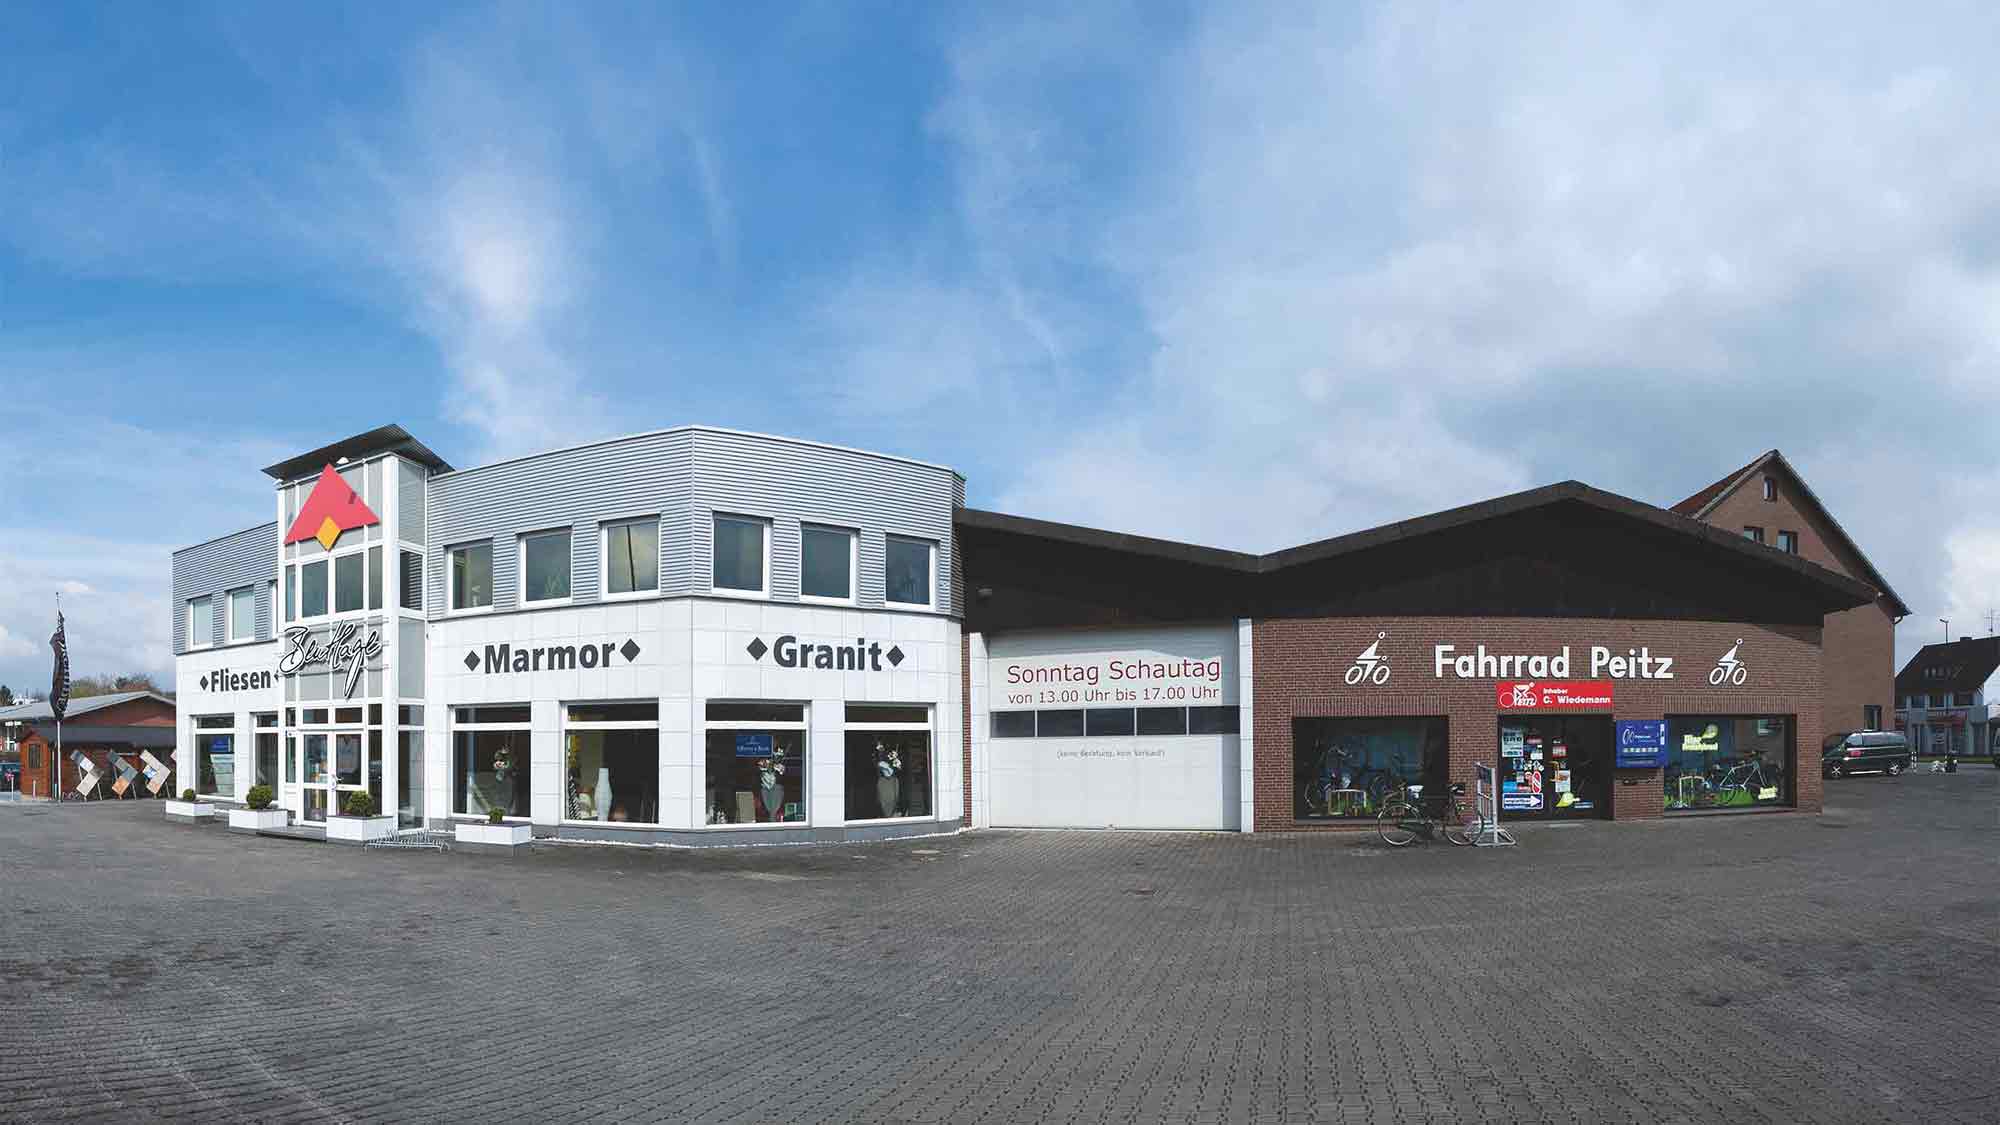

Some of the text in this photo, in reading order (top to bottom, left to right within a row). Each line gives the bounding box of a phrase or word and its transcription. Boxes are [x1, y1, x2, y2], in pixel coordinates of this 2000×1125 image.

[484, 639, 616, 674] Marmor
[773, 635, 882, 671] Granit
[1435, 644, 1674, 679] Fahrrad Peitz
[210, 668, 272, 693] Fliesen
[1007, 659, 1220, 685] Sonntag Schautag
[1008, 685, 1219, 704] von 13.00 Uhr bis 17.00 Uhr
[1543, 696, 1610, 704] C. Wiedemann
